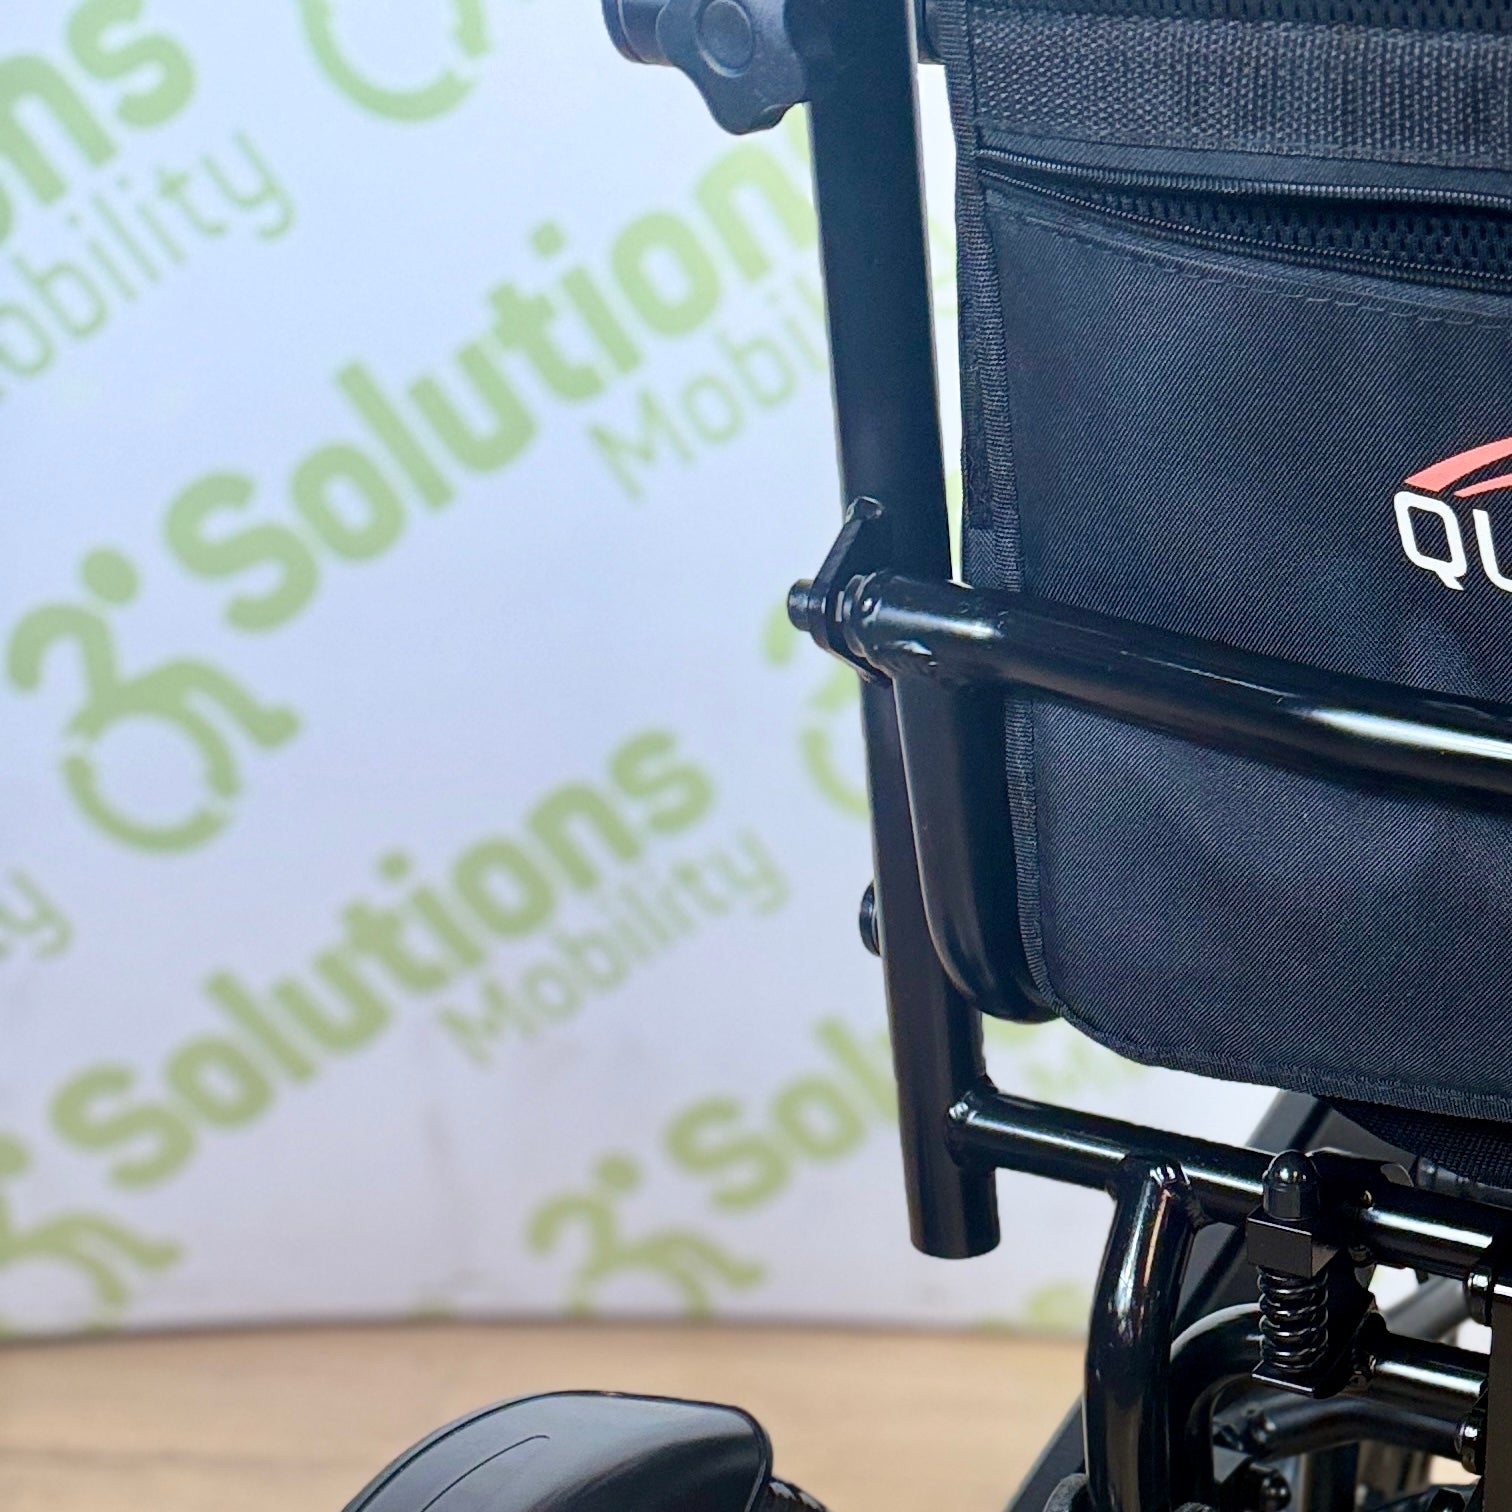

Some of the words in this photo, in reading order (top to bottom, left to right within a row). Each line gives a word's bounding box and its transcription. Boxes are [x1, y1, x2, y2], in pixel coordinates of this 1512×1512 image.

[163, 105, 822, 634] Solution
[48, 725, 716, 1188] Solutions
[440, 826, 788, 1072] Mobility
